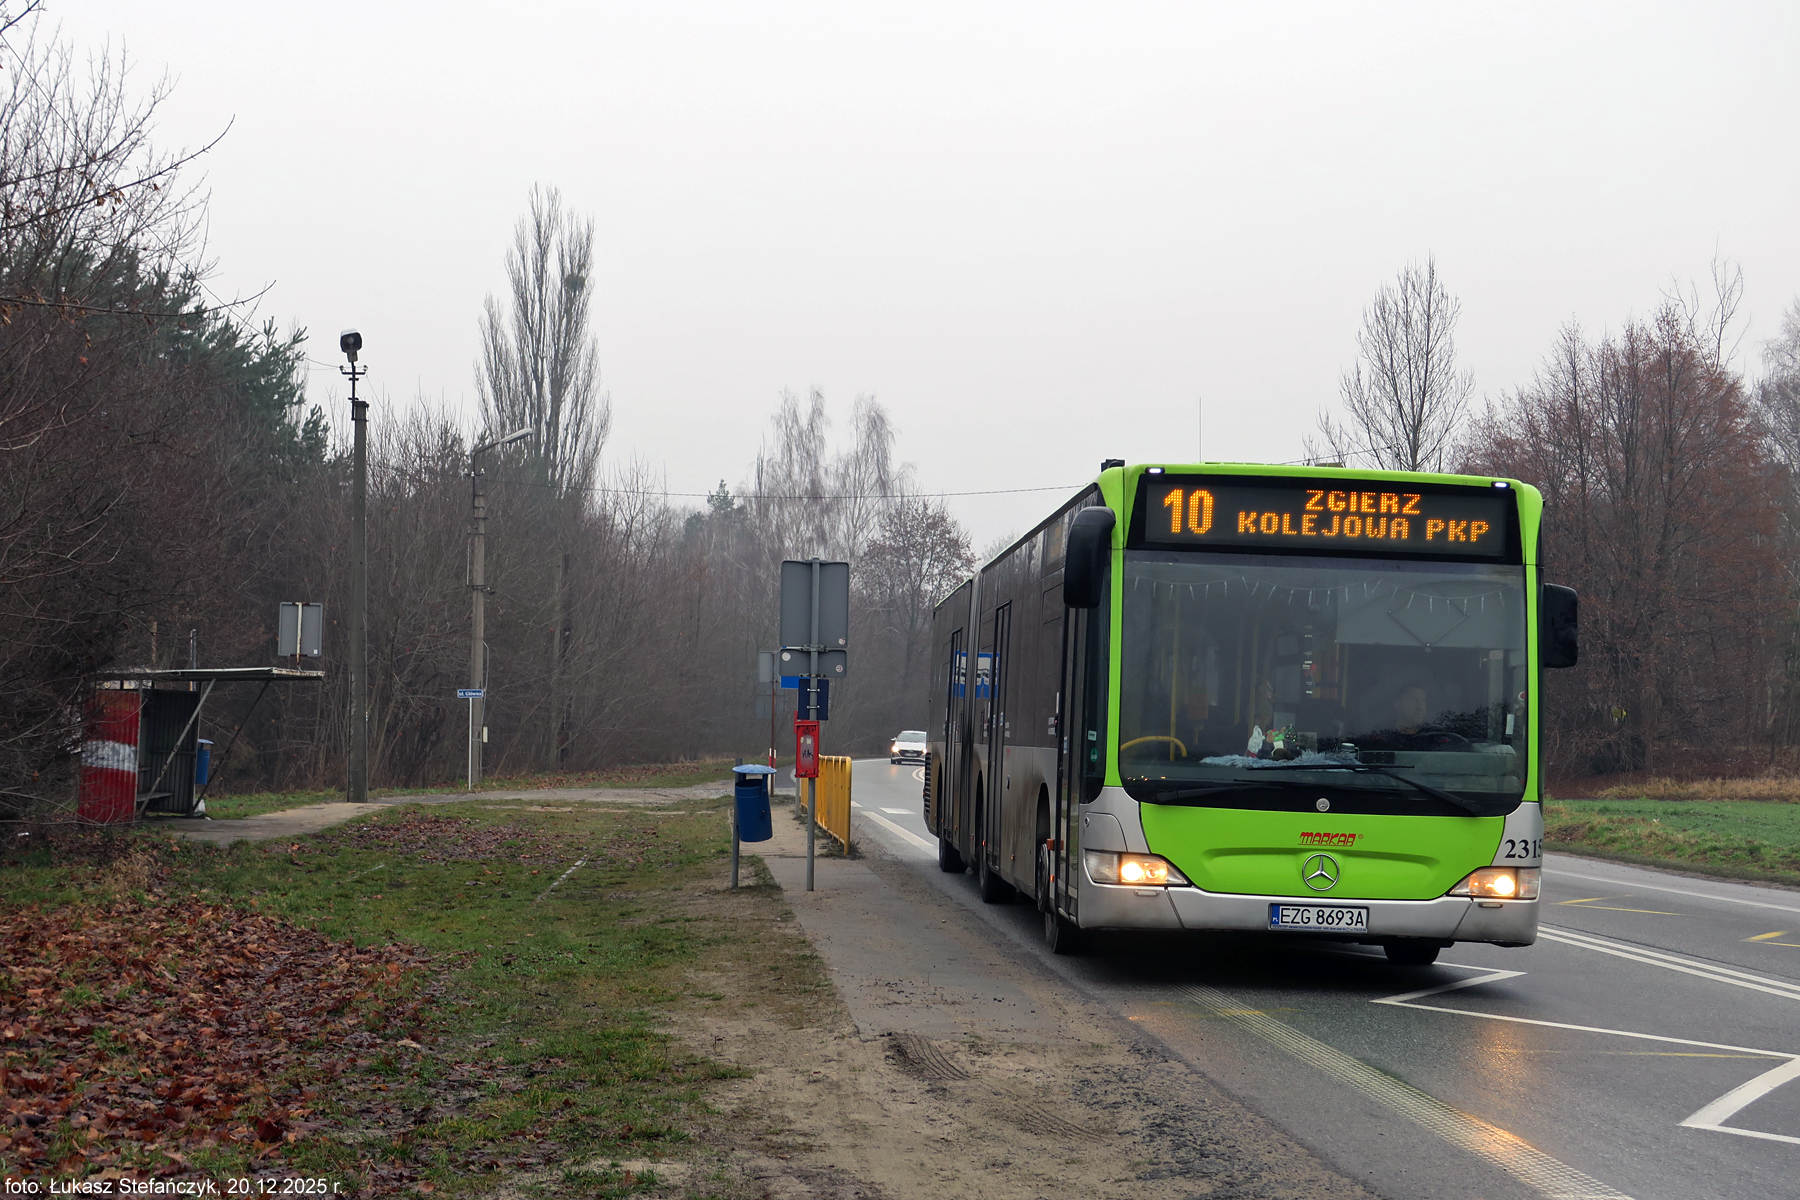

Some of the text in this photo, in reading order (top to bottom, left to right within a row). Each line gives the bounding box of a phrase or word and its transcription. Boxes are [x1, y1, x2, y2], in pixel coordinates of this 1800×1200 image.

[1163, 488, 1214, 534] 10
[1305, 489, 1421, 515] ZGIERZ
[1237, 511, 1491, 543] KOLEJOWA PKP
[1298, 832, 1357, 847] MARKAB
[1280, 907, 1364, 927] EZG 8693A
